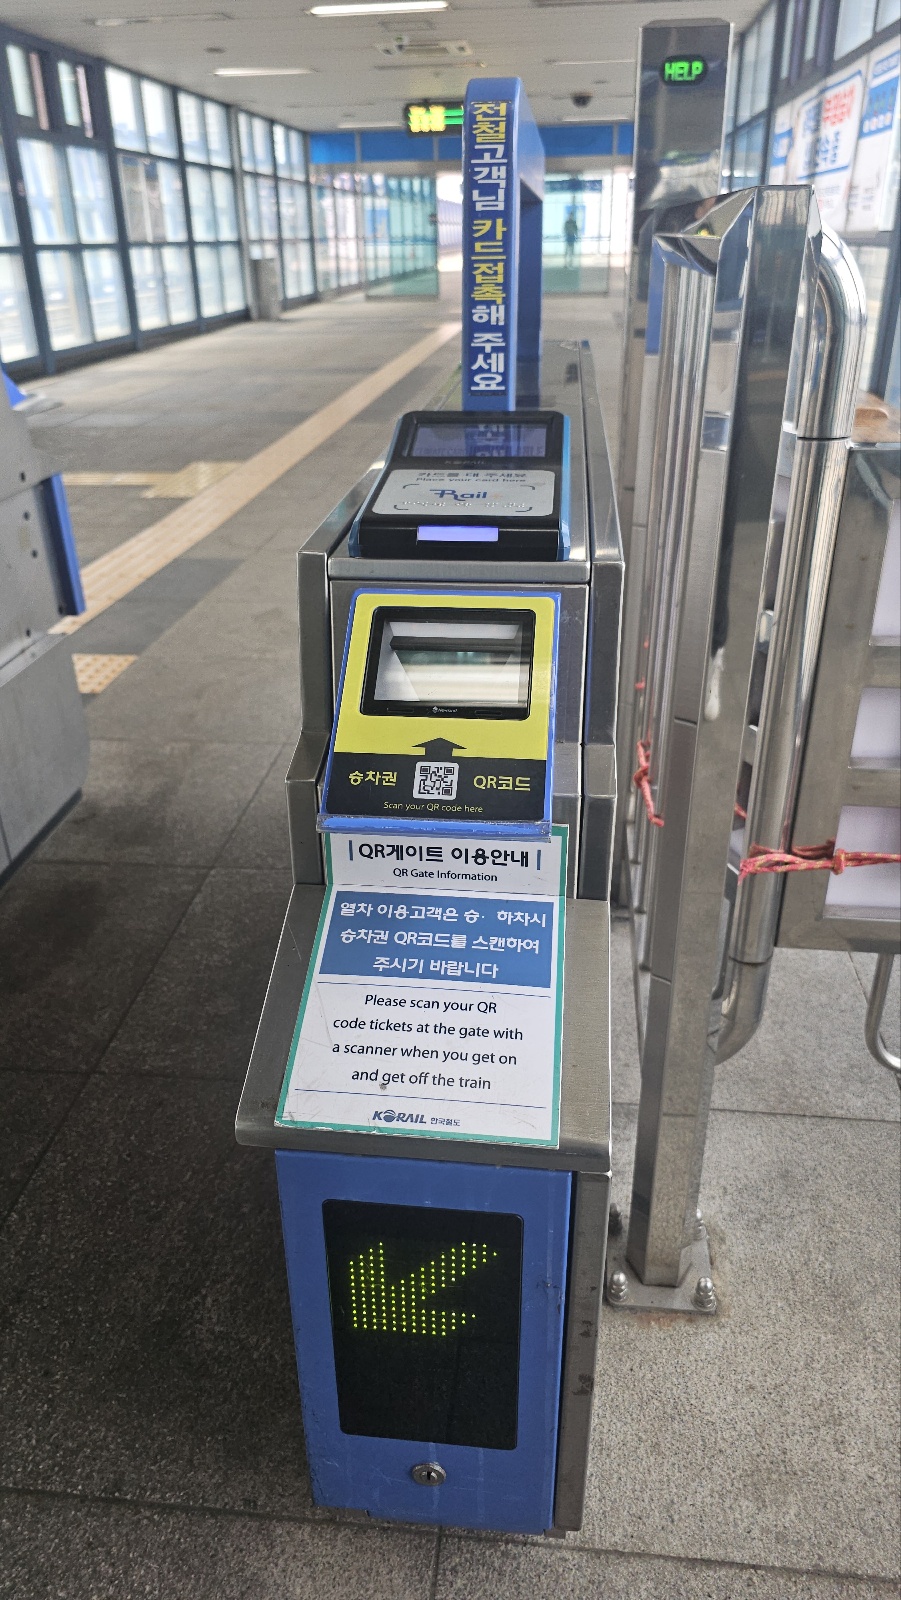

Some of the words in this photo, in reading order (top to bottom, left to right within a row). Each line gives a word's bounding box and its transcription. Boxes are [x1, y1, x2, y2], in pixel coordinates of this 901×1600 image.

[664, 61, 704, 82] HELP
[470, 101, 507, 212] 전철고객님
[470, 218, 508, 327] 카드접촉해
[470, 332, 507, 392] 주세요
[348, 770, 398, 787] 승차권
[473, 775, 531, 792] QR코드
[383, 801, 403, 810] Scan
[405, 803, 425, 812] your
[426, 803, 440, 811] QR
[441, 803, 463, 812] code
[464, 804, 484, 813] here
[358, 843, 444, 863] QR게이트
[451, 847, 530, 868] 이용안내
[393, 867, 409, 878] QR
[410, 868, 435, 879] Gate
[437, 870, 498, 882] Information
[340, 902, 374, 918] 열차
[377, 904, 459, 922] 이용고객은
[496, 910, 547, 928] 하차시
[340, 928, 389, 945] 승차권
[393, 931, 467, 949] QR코드를
[472, 935, 540, 954] 스캔하여
[372, 956, 424, 974] 주시기
[429, 959, 499, 979] 바랍니다
[364, 994, 407, 1008] Please
[410, 998, 440, 1010] scan
[443, 1001, 475, 1014] your
[477, 1001, 497, 1014] QR
[333, 1017, 366, 1030] code
[369, 1018, 413, 1033] tickets
[416, 1022, 430, 1034] at
[433, 1022, 456, 1036] the
[458, 1026, 490, 1041] gate
[493, 1026, 524, 1041] with
[332, 1044, 341, 1053] a
[343, 1044, 398, 1057] scanner
[401, 1045, 439, 1060] when
[442, 1049, 469, 1063] you
[472, 1050, 496, 1065] get
[498, 1054, 518, 1066] on
[351, 1069, 379, 1082] and
[382, 1071, 406, 1086] get
[408, 1071, 430, 1085] off
[432, 1073, 456, 1087] the
[458, 1076, 492, 1090] train
[372, 1109, 427, 1124] KORAIL
